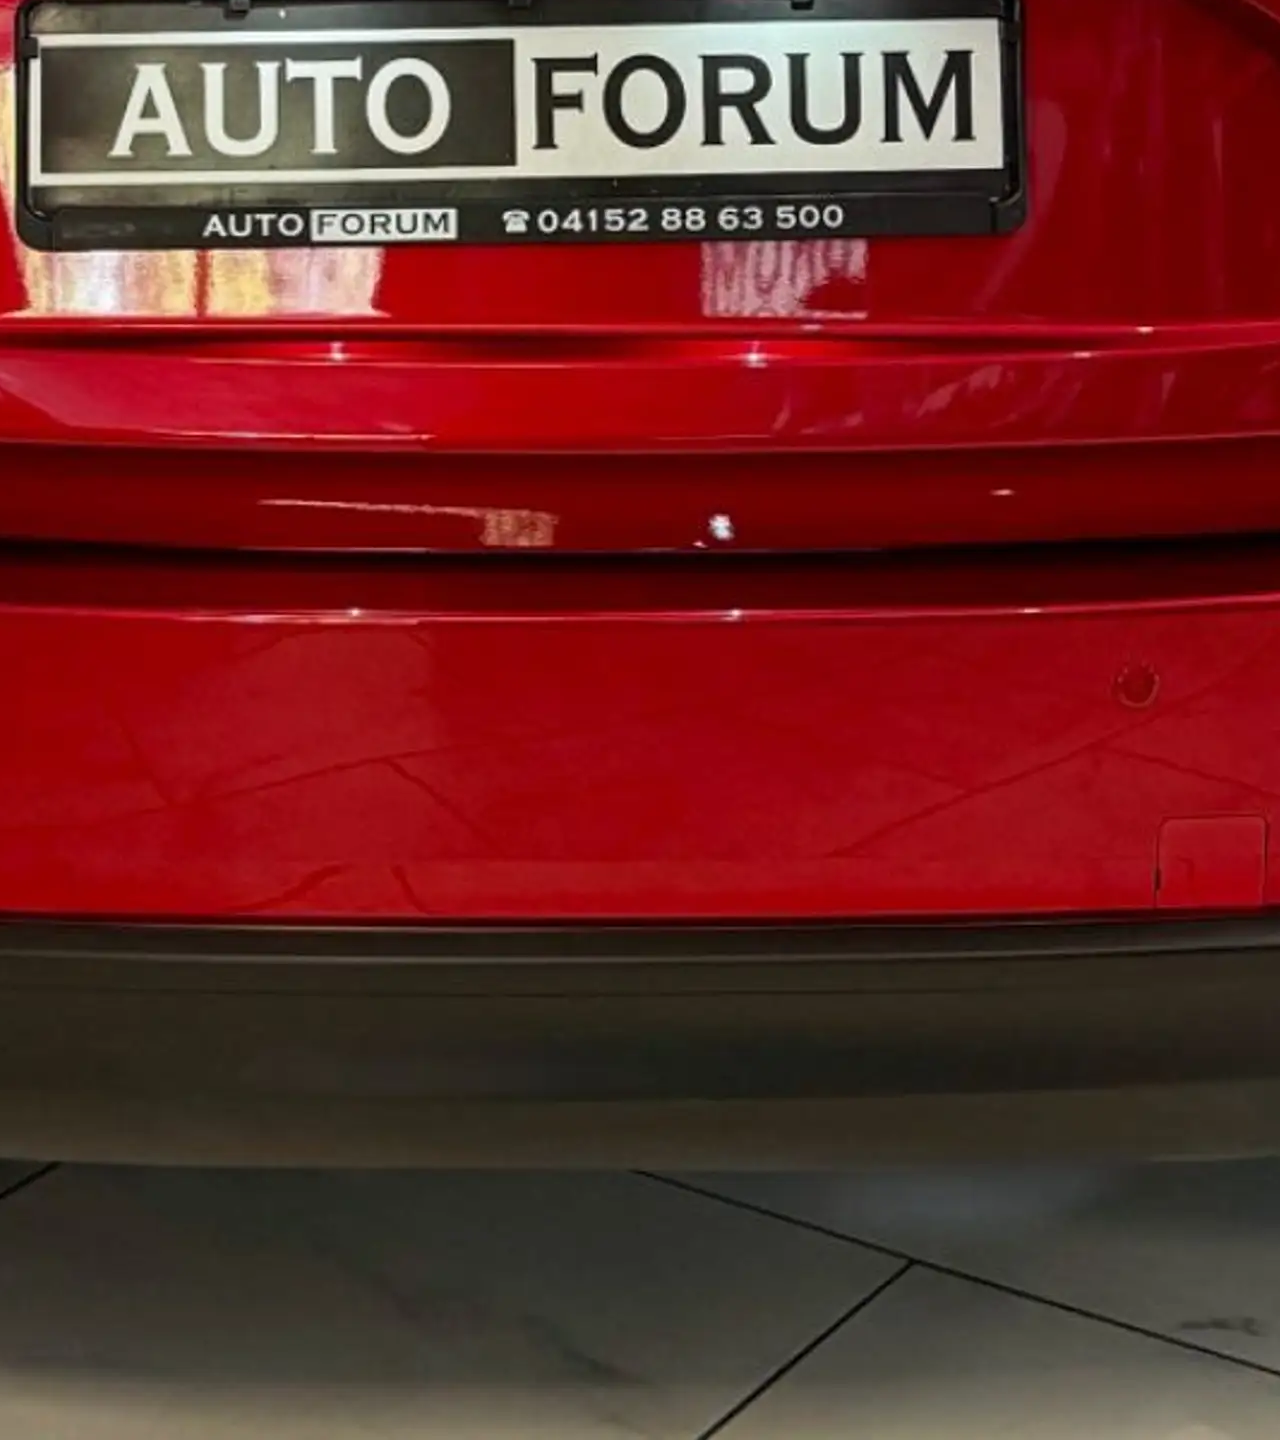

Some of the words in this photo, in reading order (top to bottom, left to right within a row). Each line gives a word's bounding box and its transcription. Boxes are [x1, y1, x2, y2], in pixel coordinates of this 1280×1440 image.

[108, 56, 451, 158] AUTO
[531, 50, 976, 149] FORUM
[202, 212, 304, 237] AUTO
[317, 211, 451, 237] FORUM
[537, 209, 649, 232] 04152
[661, 207, 706, 230] 88
[718, 206, 763, 230] 63
[776, 205, 844, 228] 500
